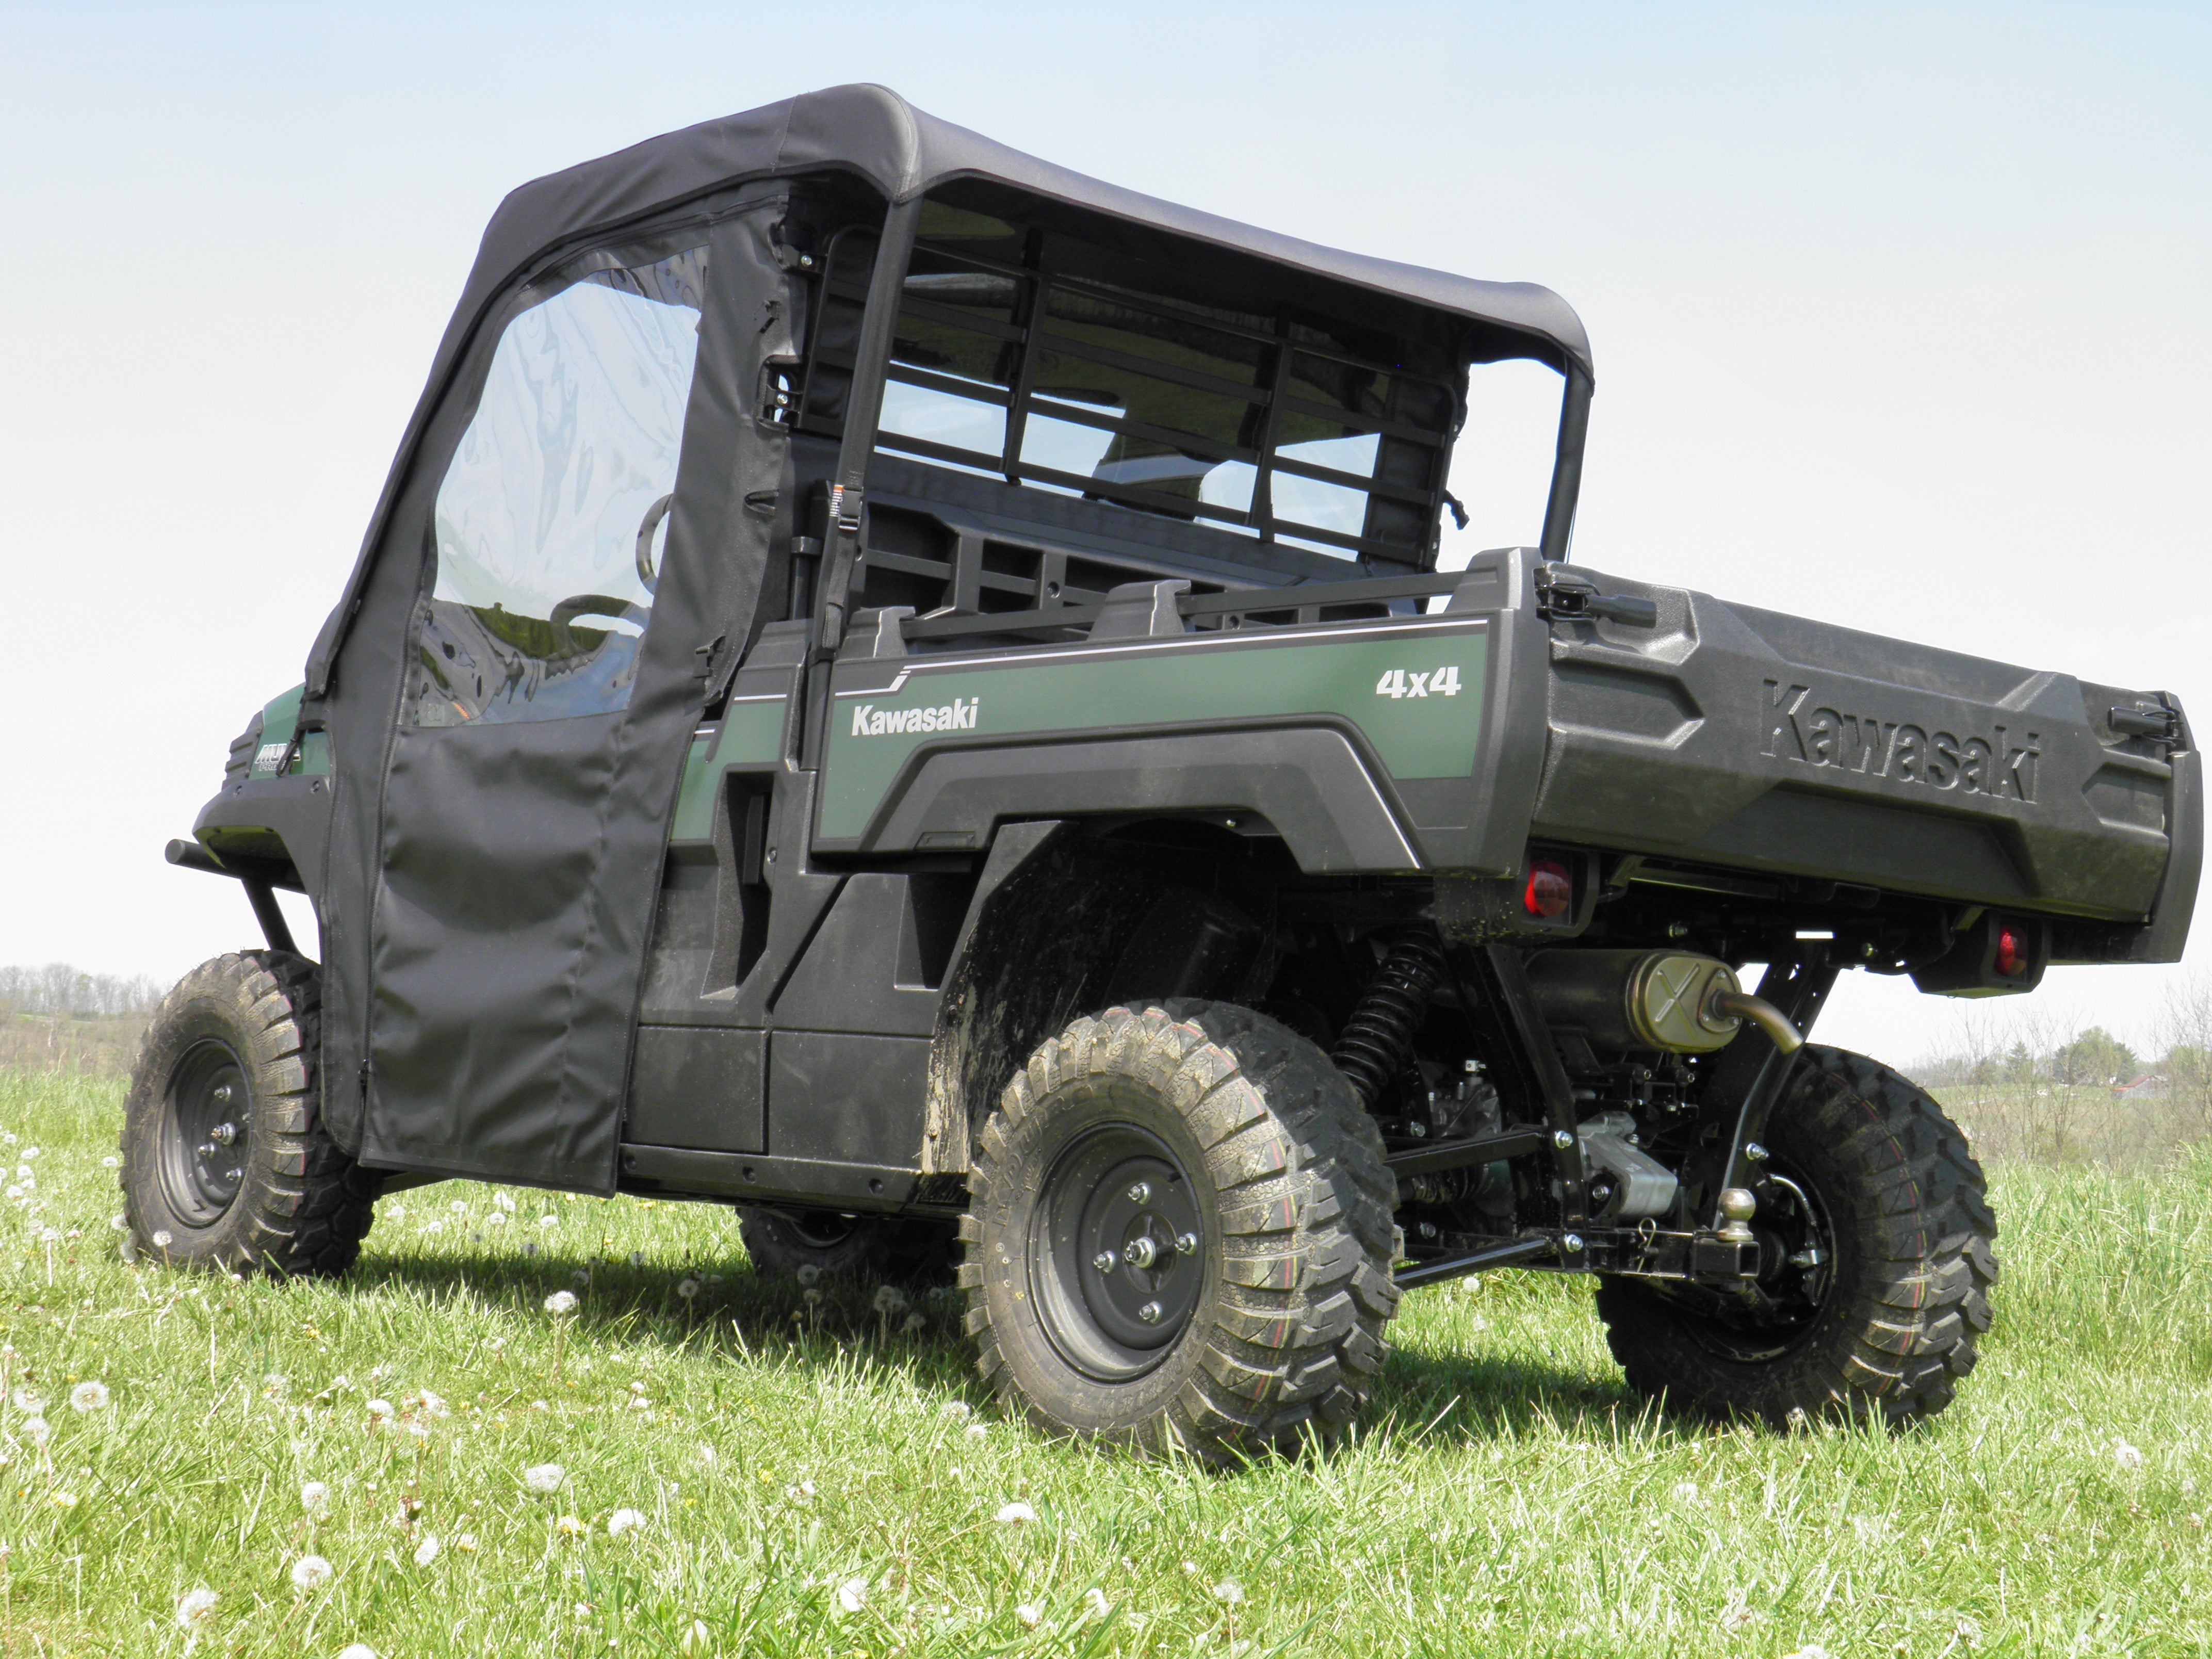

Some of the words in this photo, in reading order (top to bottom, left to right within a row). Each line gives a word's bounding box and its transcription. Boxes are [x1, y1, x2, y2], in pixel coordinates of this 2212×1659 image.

[1376, 666, 1462, 698] 4x4
[851, 697, 979, 736] Kawasaki
[1759, 678, 2040, 804] Kawasaki
